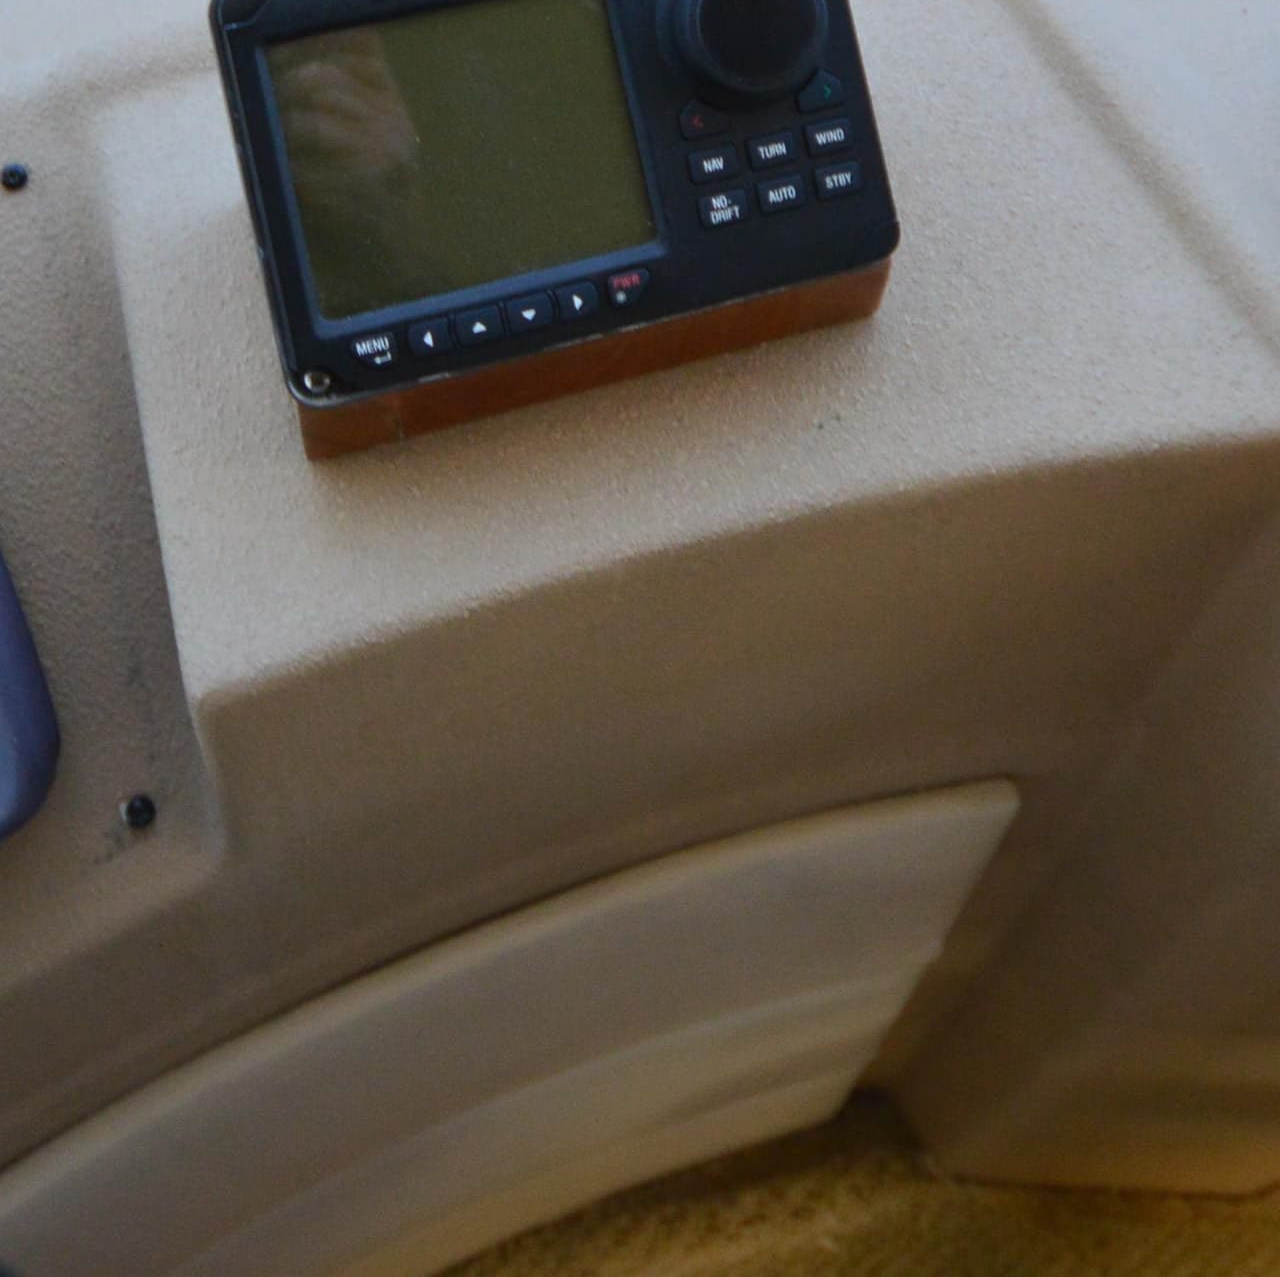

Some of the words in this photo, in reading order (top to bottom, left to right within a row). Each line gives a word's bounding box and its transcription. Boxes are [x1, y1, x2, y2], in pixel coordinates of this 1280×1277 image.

[814, 127, 845, 146] WIND
[757, 142, 788, 160] TURN
[702, 156, 724, 173] NAV
[824, 172, 853, 189] STBY
[768, 185, 797, 204] AUTO
[709, 205, 741, 225] DRIFT
[612, 274, 641, 290] PWR
[355, 335, 390, 357] MENU
